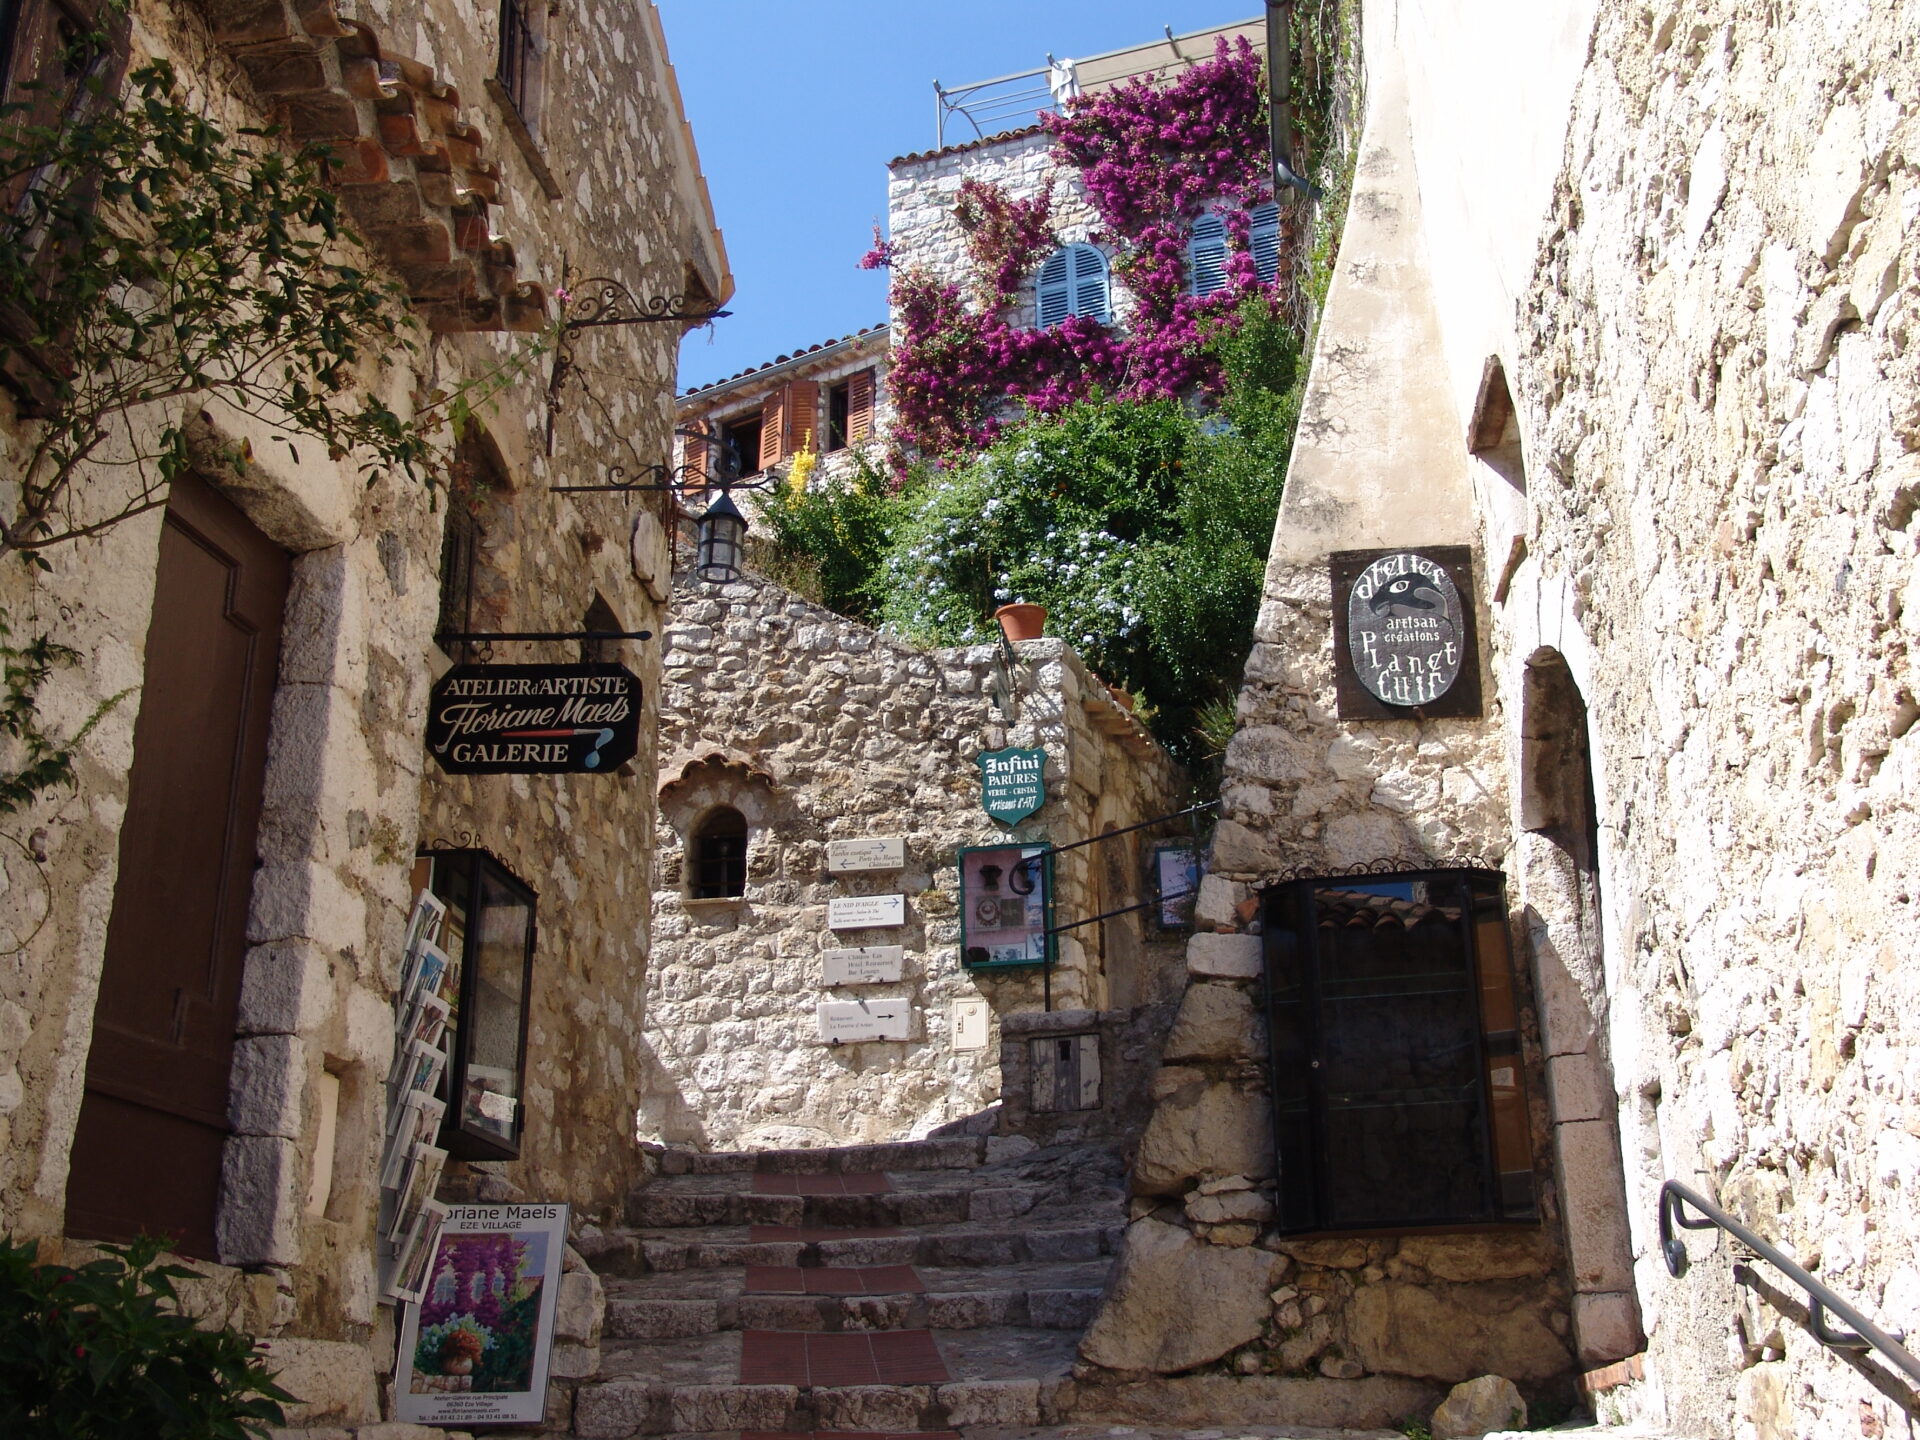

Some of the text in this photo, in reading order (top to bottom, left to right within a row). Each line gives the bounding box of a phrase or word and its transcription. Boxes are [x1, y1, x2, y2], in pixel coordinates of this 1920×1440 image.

[1386, 616, 1439, 630] artisan
[1360, 631, 1457, 674] Planet
[442, 679, 532, 697] ATELIER
[435, 696, 630, 754] Floriane Maels
[452, 743, 569, 763] GALERIE
[985, 754, 1040, 774] Infini
[988, 773, 1038, 786] PARURES
[987, 789, 1008, 797] VERRE
[1012, 786, 1038, 795] CRISTAL
[446, 1206, 557, 1220] oriane Maels
[460, 1221, 523, 1230] EZE VILLAGE
